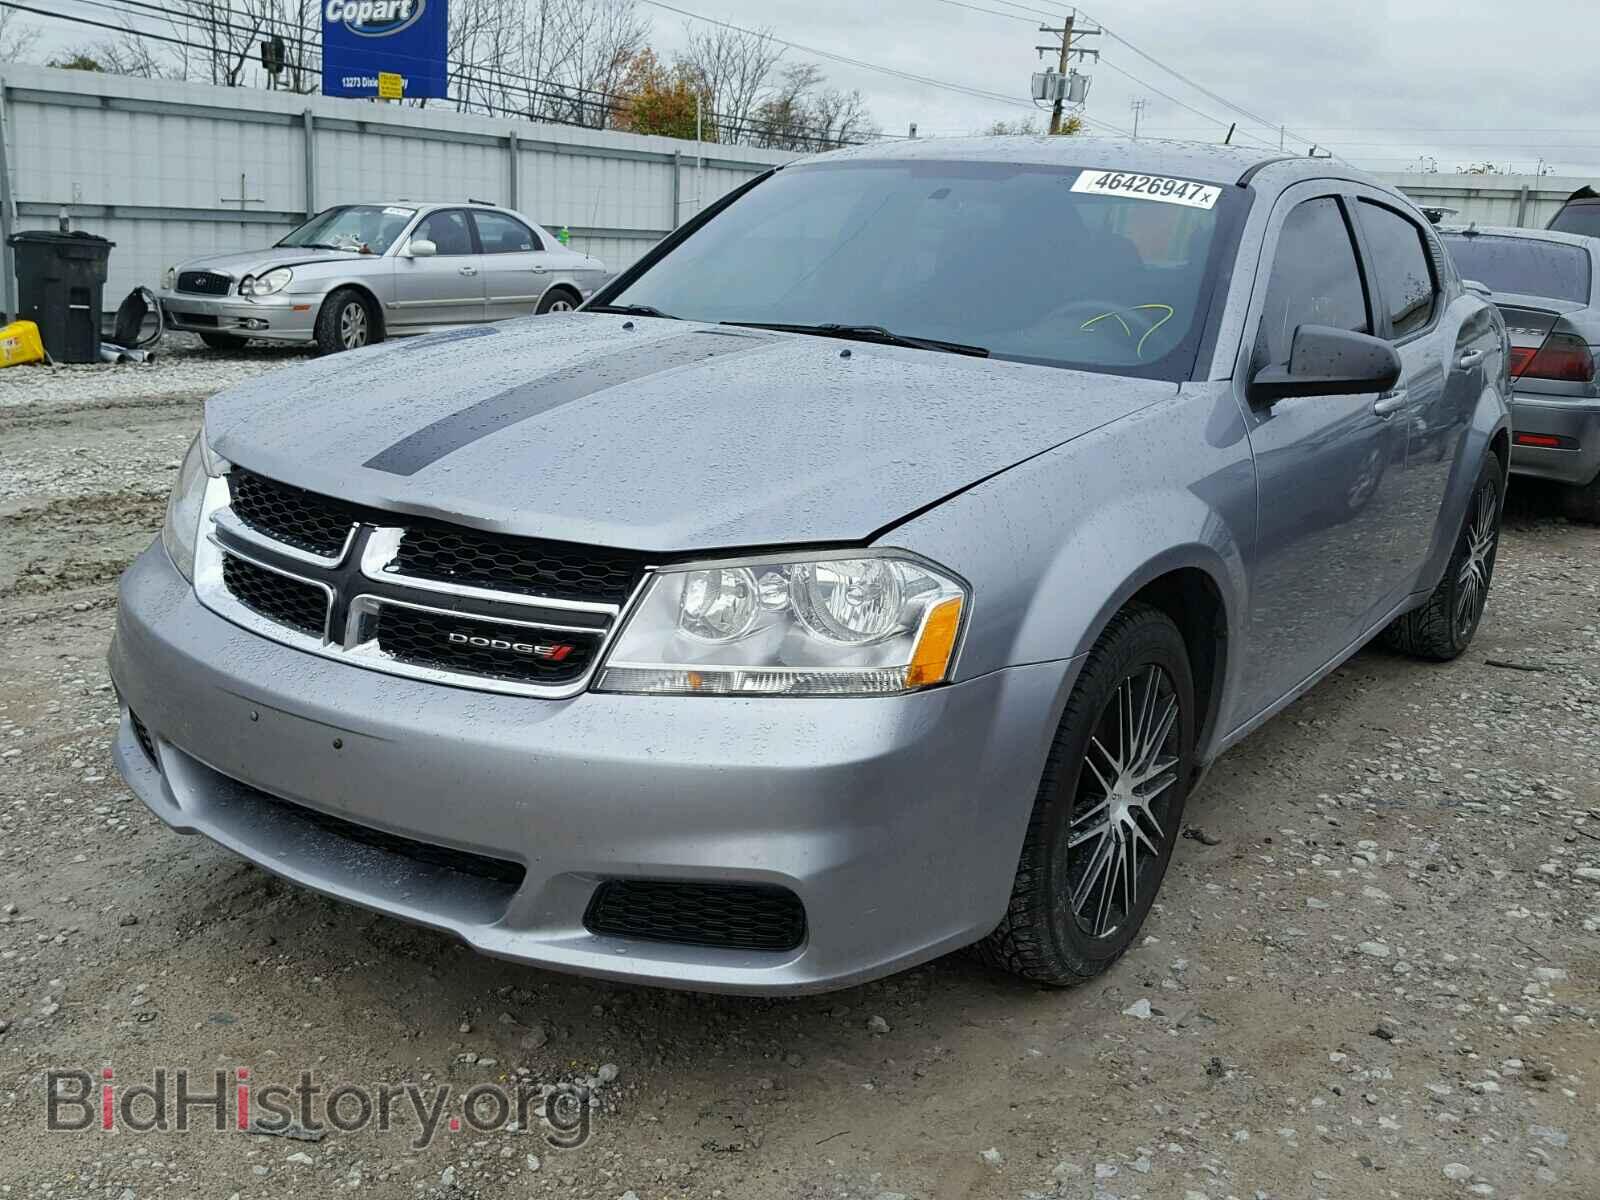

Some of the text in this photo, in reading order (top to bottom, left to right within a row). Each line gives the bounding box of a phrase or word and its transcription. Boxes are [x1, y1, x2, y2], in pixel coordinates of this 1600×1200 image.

[325, 0, 409, 28] Copart
[342, 76, 361, 88] 13273
[449, 632, 556, 656] DODGE
